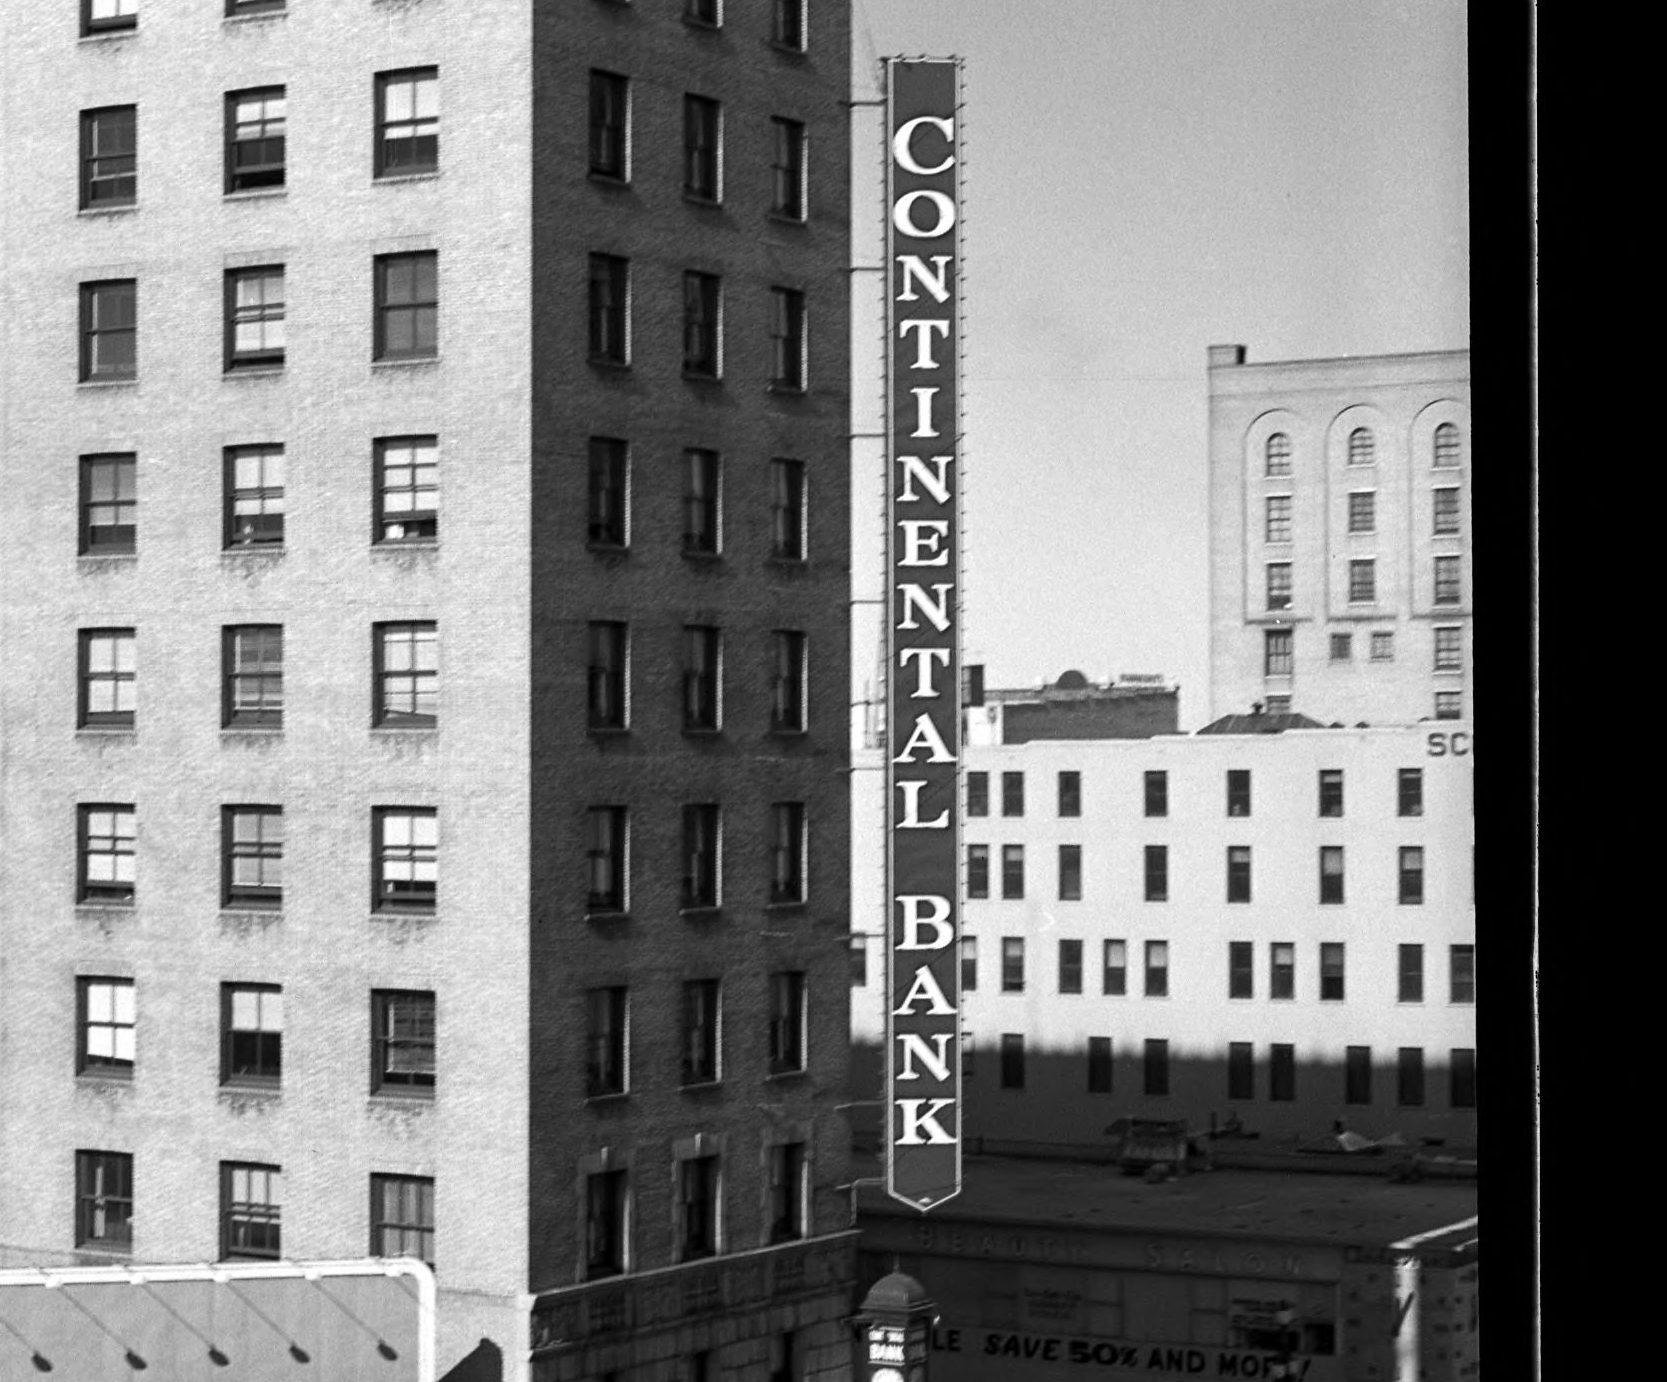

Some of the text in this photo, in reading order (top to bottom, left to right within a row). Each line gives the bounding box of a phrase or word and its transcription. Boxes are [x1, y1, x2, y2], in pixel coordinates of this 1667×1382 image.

[892, 115, 959, 1146] CONTINENTAL BANK
[1427, 731, 1469, 758] SC
[983, 1333, 1061, 1362] SAVE
[1068, 1339, 1138, 1368] 50%
[1146, 1348, 1206, 1375] AND
